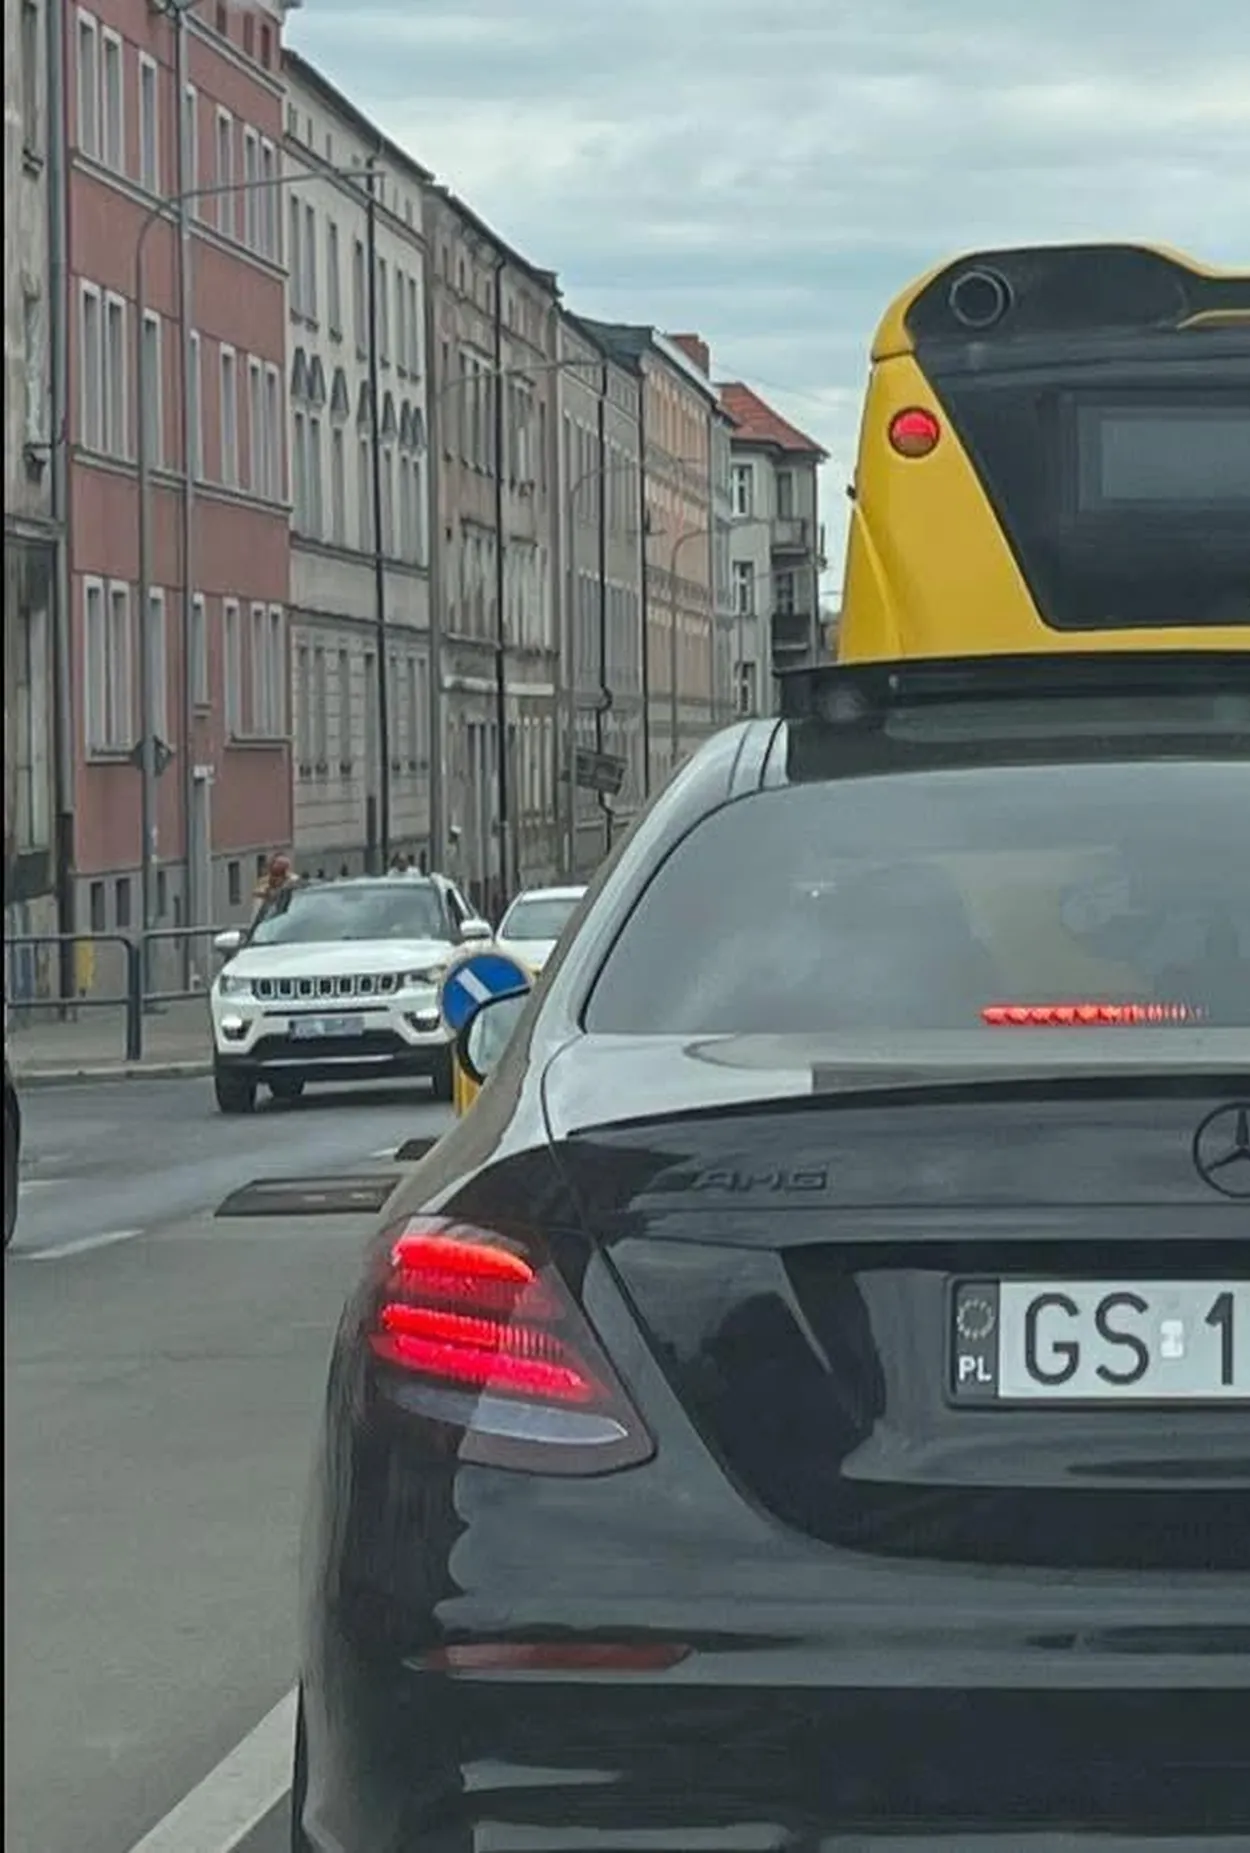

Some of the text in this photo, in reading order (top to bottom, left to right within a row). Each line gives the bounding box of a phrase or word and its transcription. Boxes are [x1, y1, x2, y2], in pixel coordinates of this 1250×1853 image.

[692, 1166, 829, 1194] AMG
[1024, 1291, 1150, 1386] GS
[958, 1355, 992, 1382] PL
